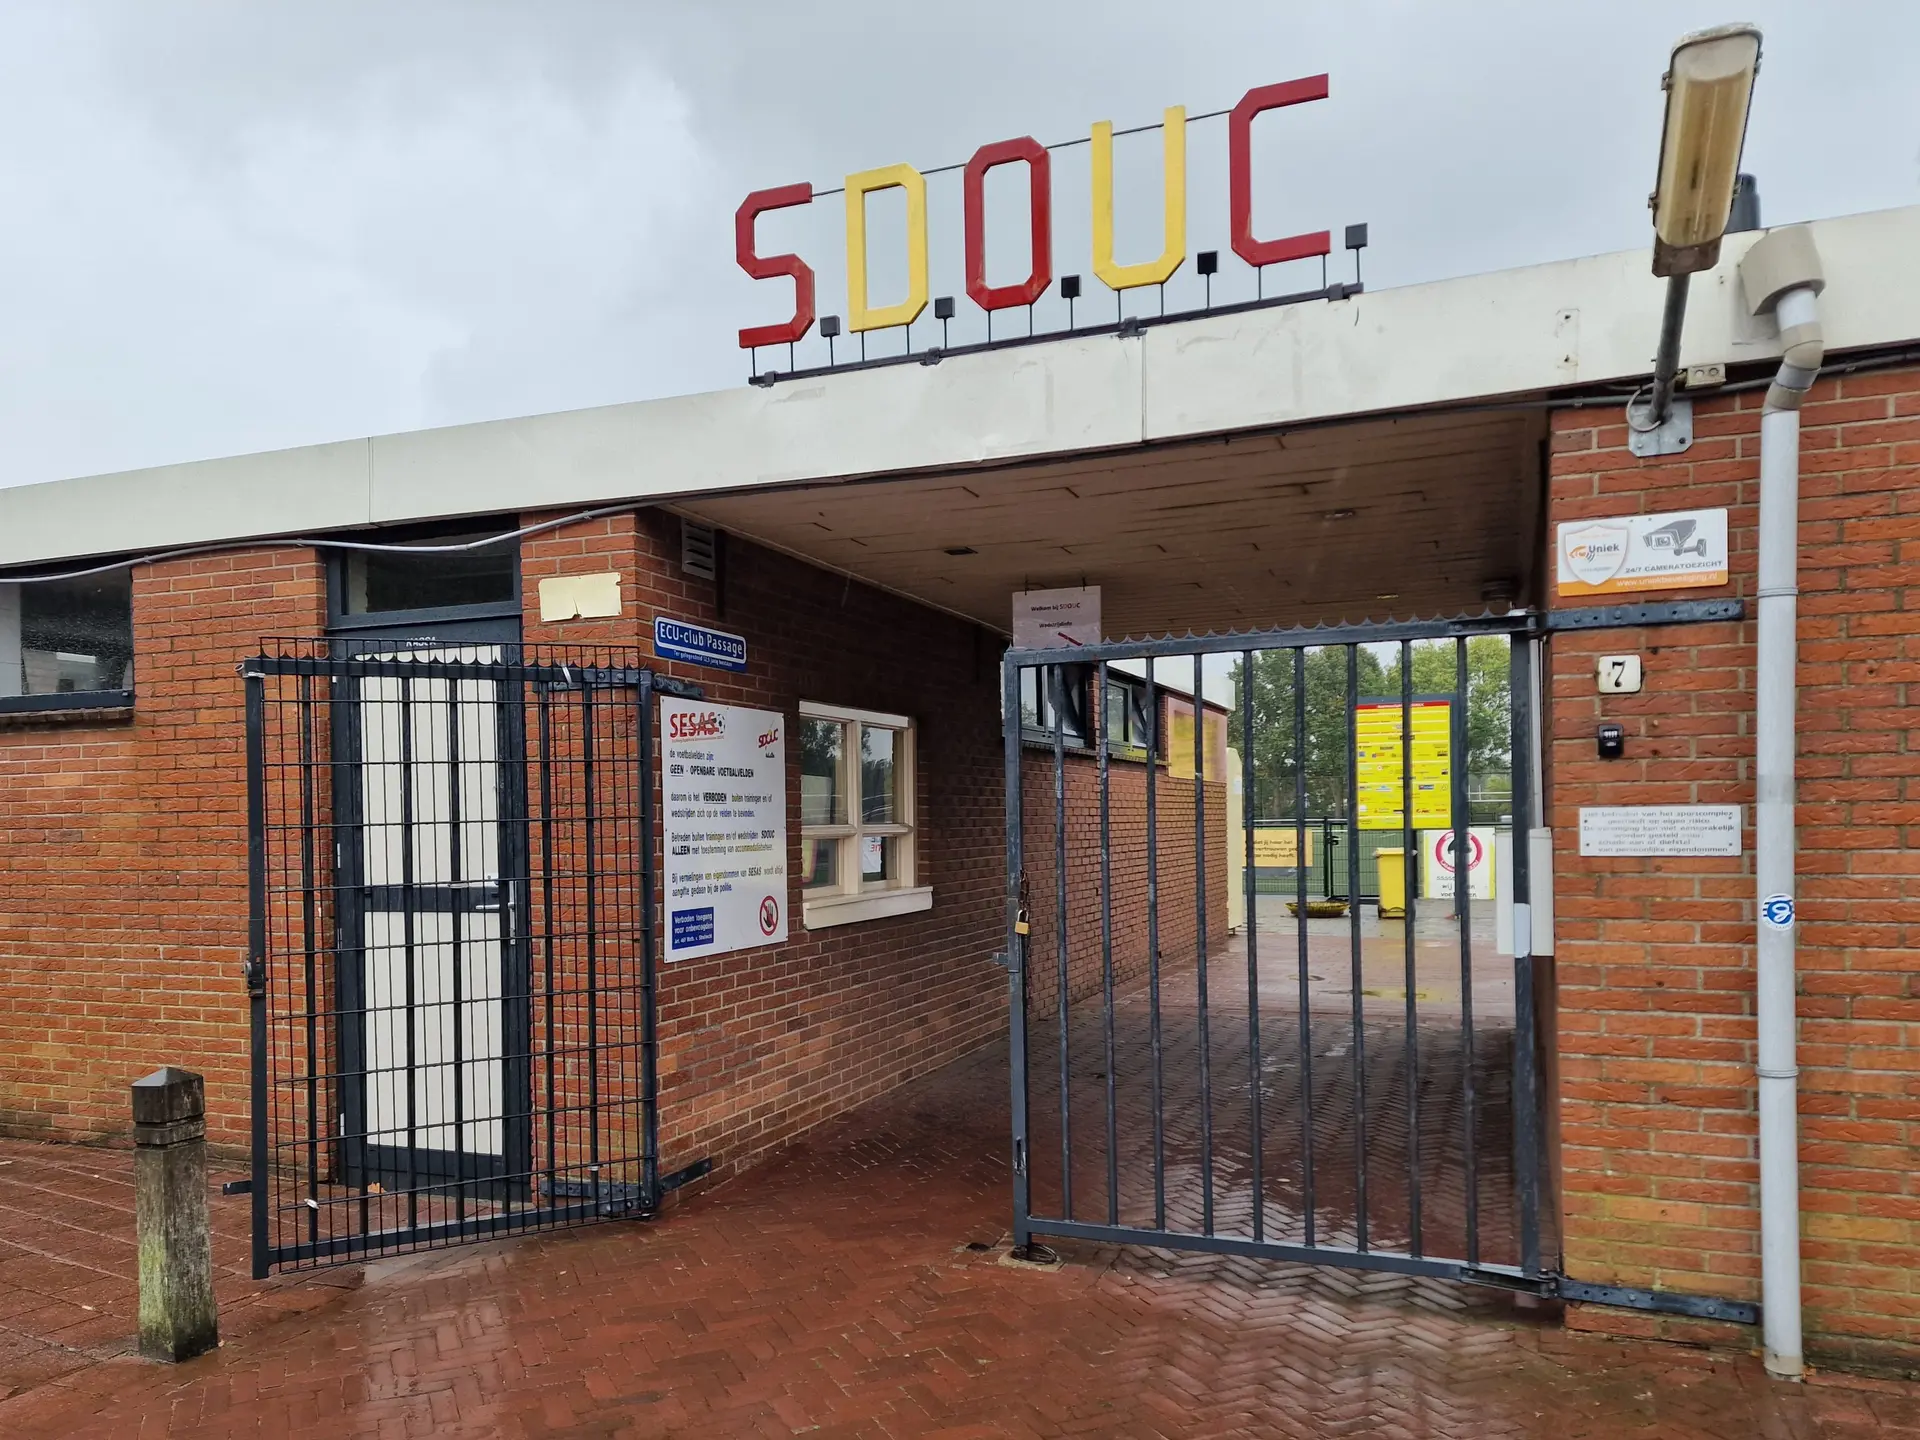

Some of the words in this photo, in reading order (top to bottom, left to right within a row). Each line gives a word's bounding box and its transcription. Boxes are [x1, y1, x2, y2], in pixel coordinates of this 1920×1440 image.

[1588, 543, 1620, 553] Uniek
[660, 623, 704, 647] ECU-club
[707, 634, 743, 657] Passage
[1611, 660, 1626, 688] 7
[670, 711, 718, 738] SESAS
[670, 764, 684, 774] GEEN
[690, 765, 715, 776] OPENBARE
[718, 766, 754, 778] VOETBALVELDEN
[671, 792, 687, 801] daarom
[703, 792, 727, 802] VERBODEN
[1676, 810, 1734, 818] sportcomplex
[760, 829, 775, 839] SDOUC
[671, 845, 690, 856] ALLEEN
[748, 866, 761, 876] SESAS
[674, 914, 695, 924] Verboden
[695, 913, 712, 921] toegang
[685, 923, 712, 932] onbevoegden
